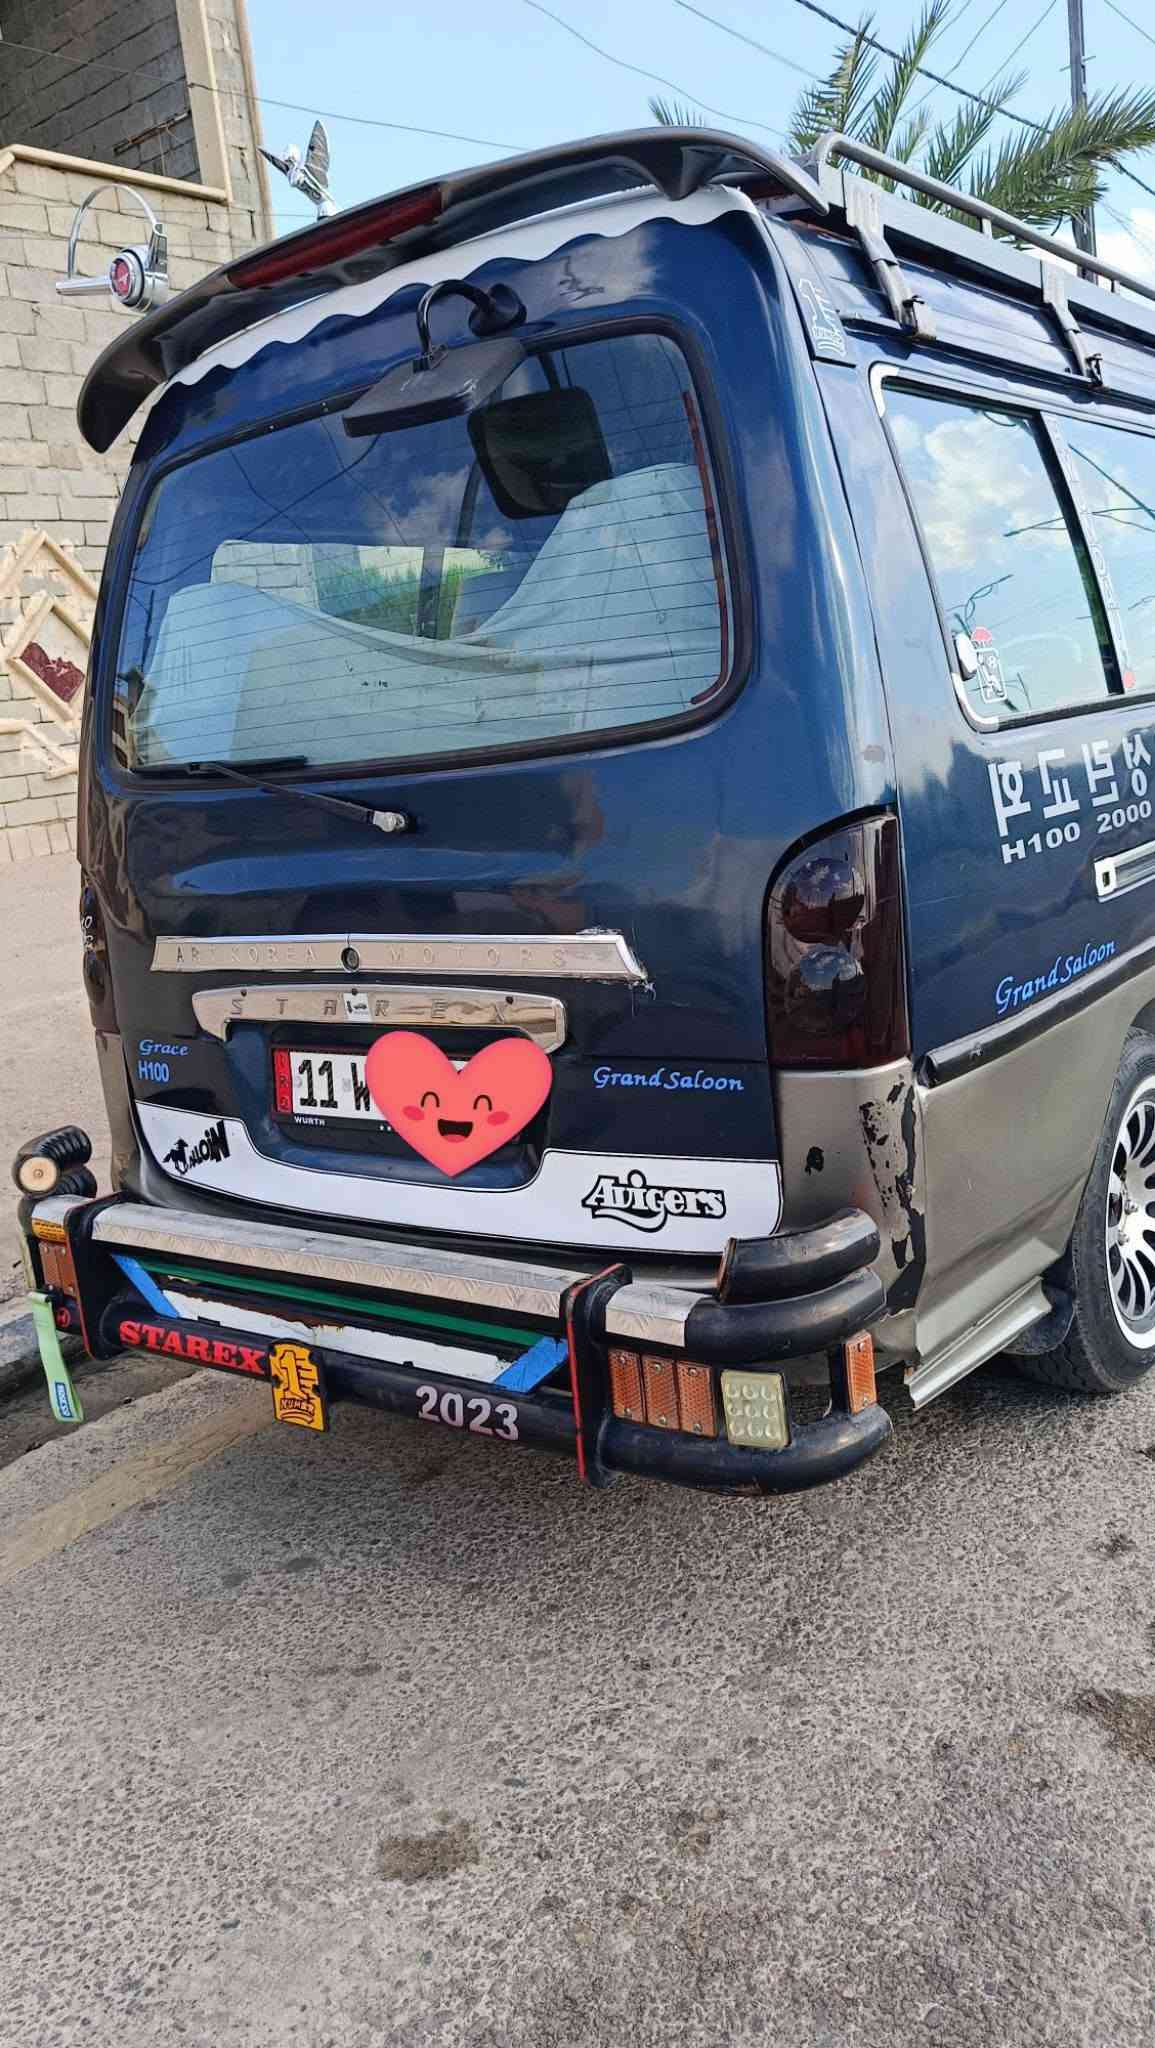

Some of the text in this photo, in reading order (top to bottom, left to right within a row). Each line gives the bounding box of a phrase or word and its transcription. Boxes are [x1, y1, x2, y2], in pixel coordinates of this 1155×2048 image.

[1001, 800, 1152, 865] H100 2000
[391, 945, 568, 968] MOTORS
[996, 940, 1115, 1015] Grand Saloon
[231, 998, 505, 1024] STAREX
[139, 1039, 189, 1056] Grace
[138, 1060, 169, 1082] H100
[299, 1059, 338, 1108] 11
[593, 1066, 744, 1090] Grand Saloon
[119, 1320, 266, 1375] STAREX
[415, 1385, 519, 1440] 2023
